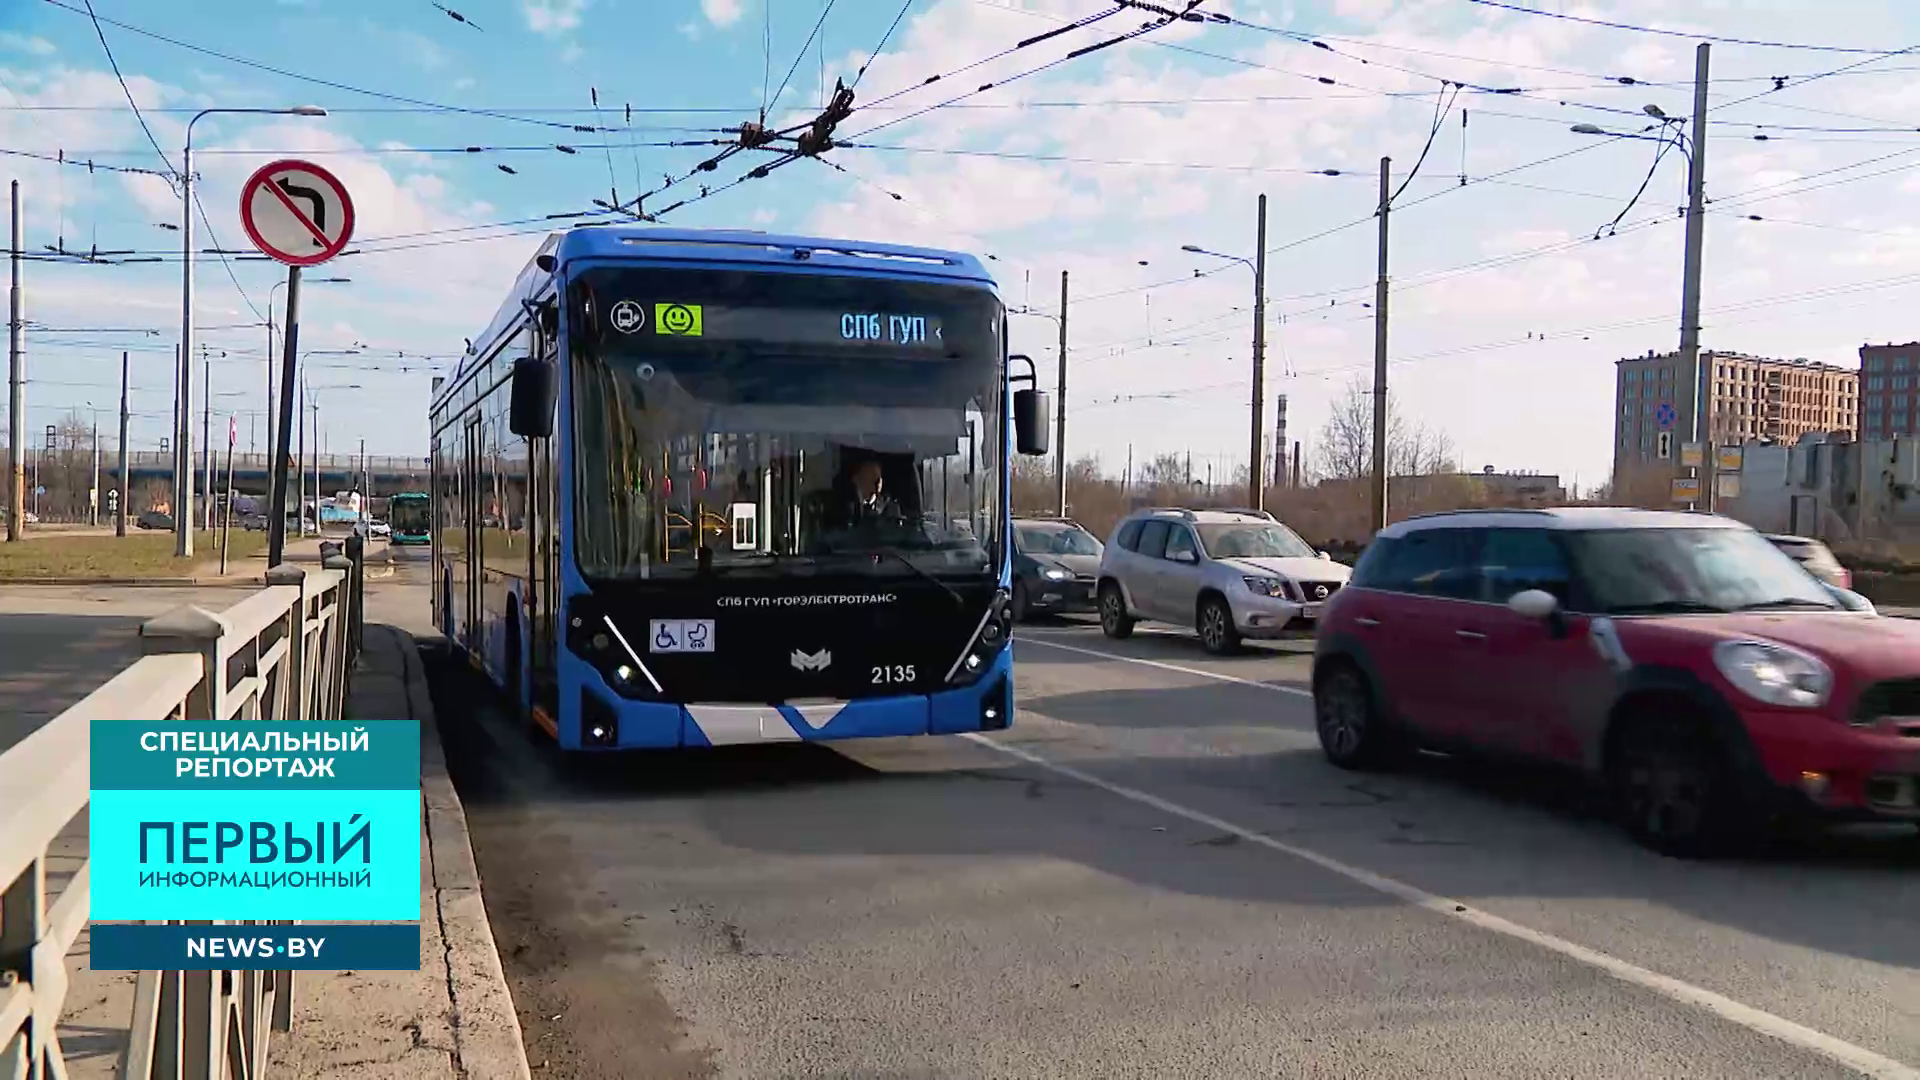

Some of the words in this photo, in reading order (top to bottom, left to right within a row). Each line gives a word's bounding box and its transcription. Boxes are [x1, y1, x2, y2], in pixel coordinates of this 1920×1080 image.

[841, 313, 881, 340] СПб
[889, 315, 926, 345] ГУП
[744, 596, 770, 606] ГУП
[871, 664, 916, 684] 2135
